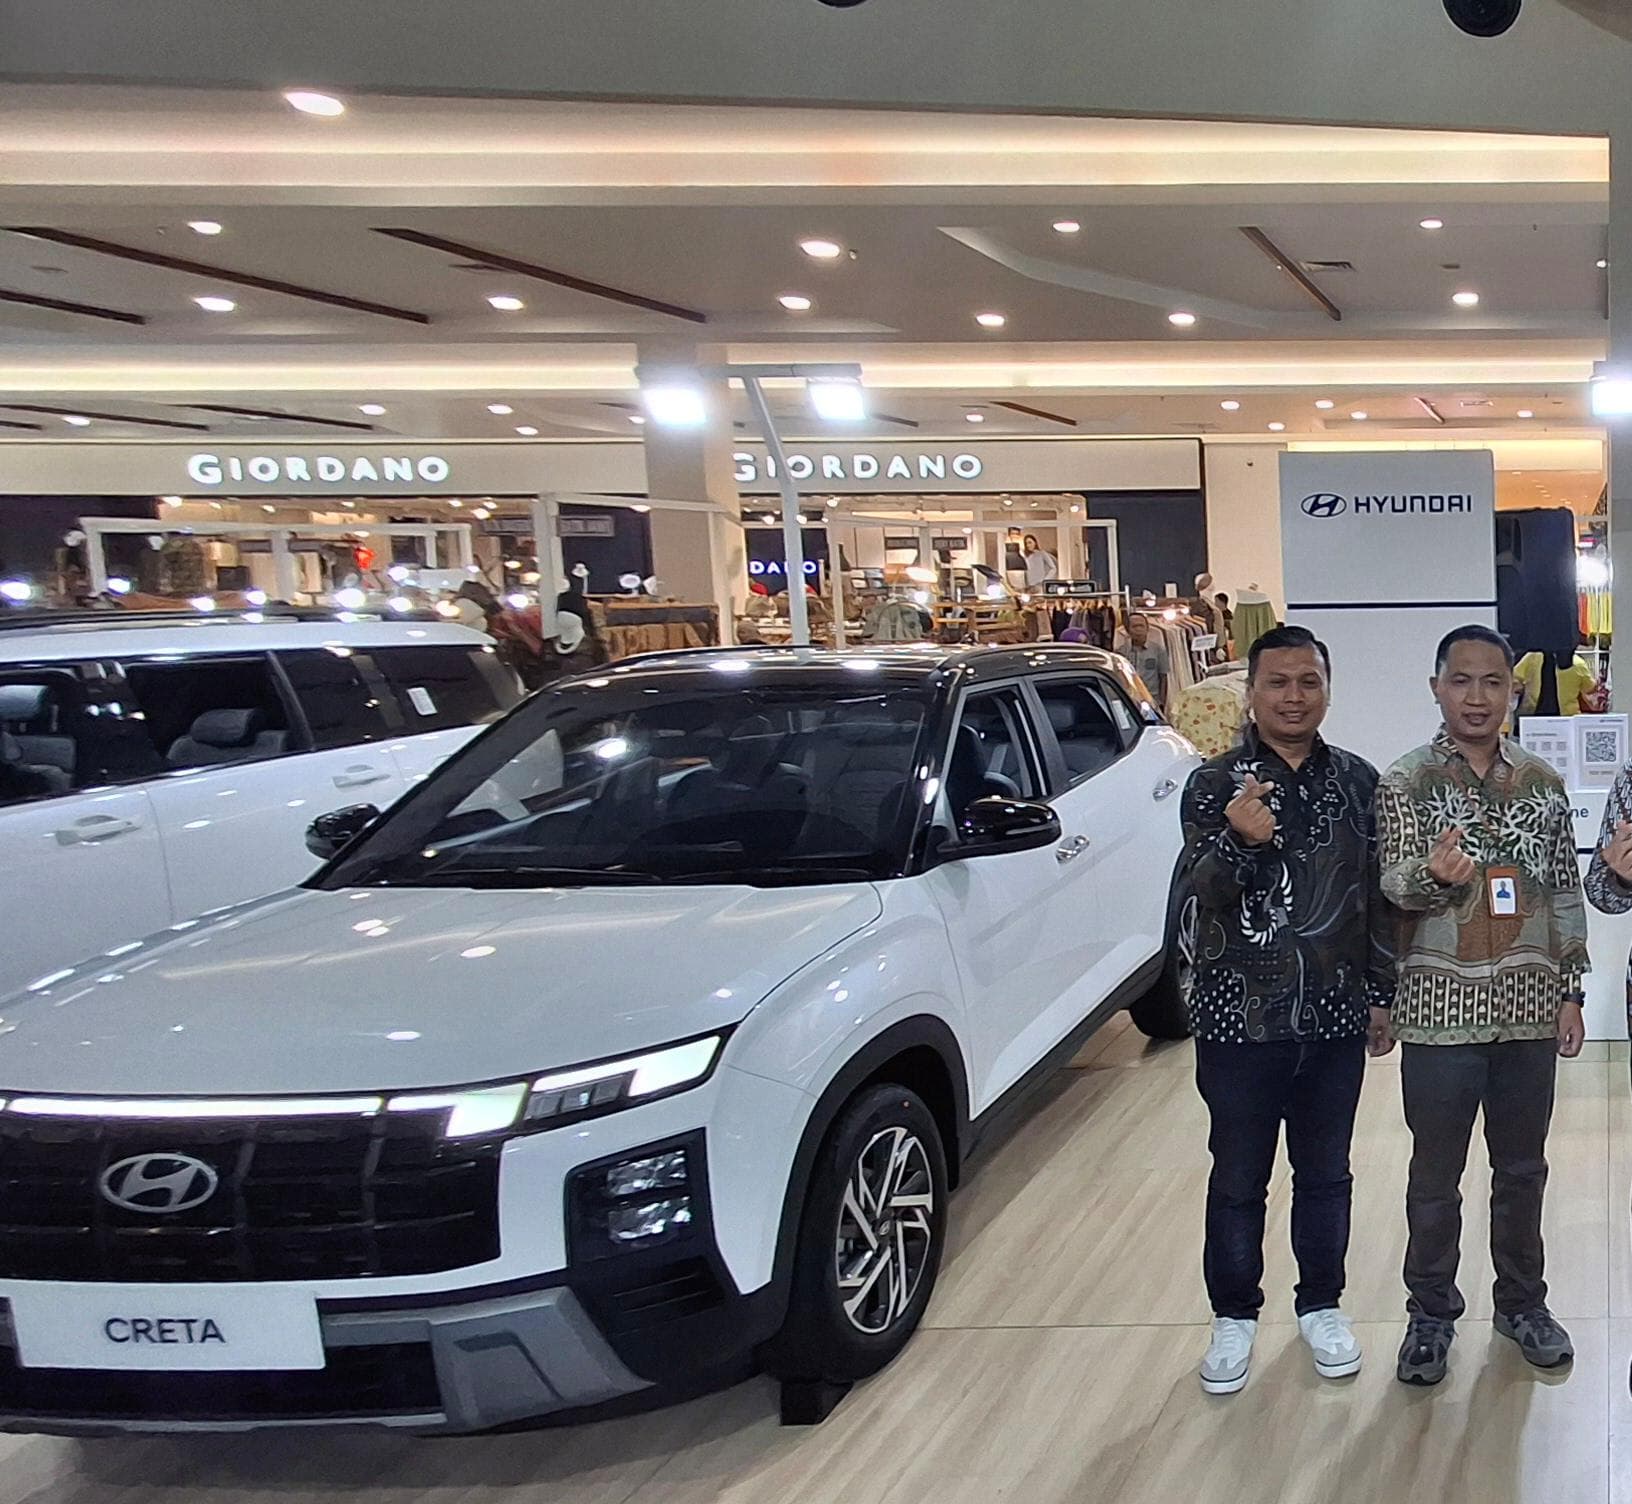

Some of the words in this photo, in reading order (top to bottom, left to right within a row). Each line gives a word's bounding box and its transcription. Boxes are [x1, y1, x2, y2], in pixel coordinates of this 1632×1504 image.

[188, 454, 449, 484] GIORDANO
[1354, 495, 1472, 514] HYUNDAI
[105, 1318, 226, 1343] CRETA
